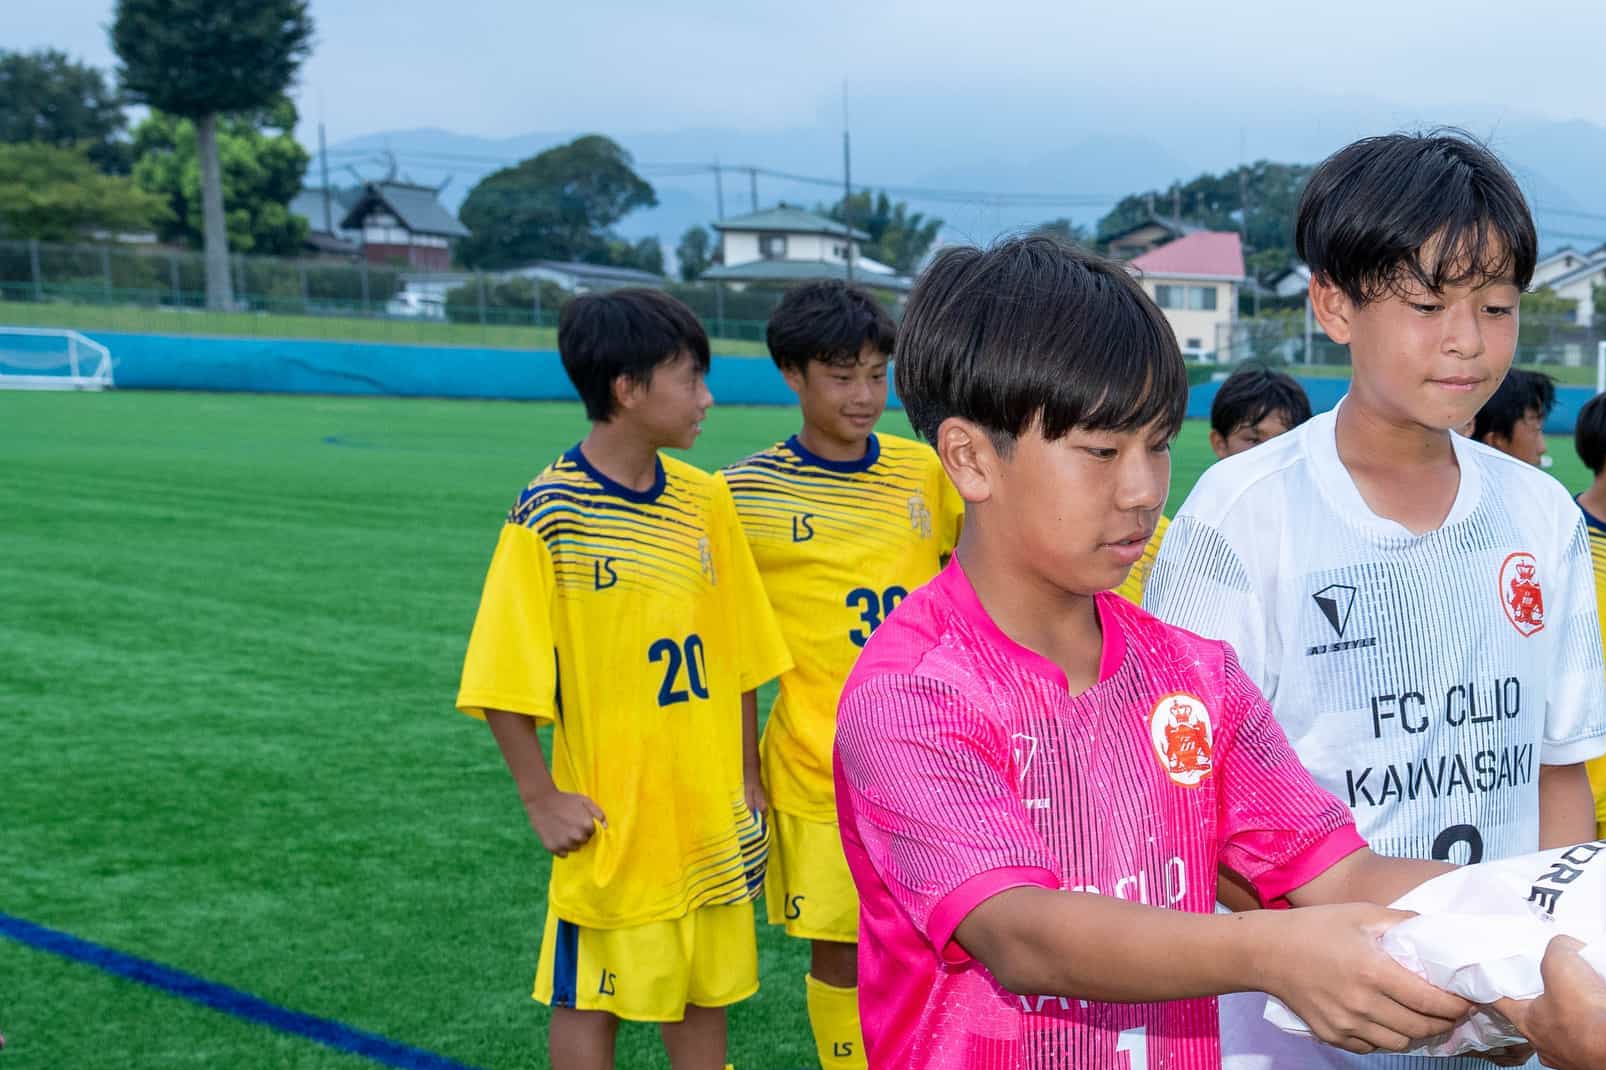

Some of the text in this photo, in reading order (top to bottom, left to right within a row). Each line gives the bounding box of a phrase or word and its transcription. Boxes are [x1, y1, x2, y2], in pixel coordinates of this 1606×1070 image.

[792, 512, 815, 543] LS
[594, 556, 619, 591] LS
[1330, 637, 1377, 653] STYLE
[647, 633, 710, 708] 20
[1371, 676, 1521, 739] FC CLIO
[1345, 742, 1534, 808] KAWASAKI
[833, 1042, 853, 1057] LS
